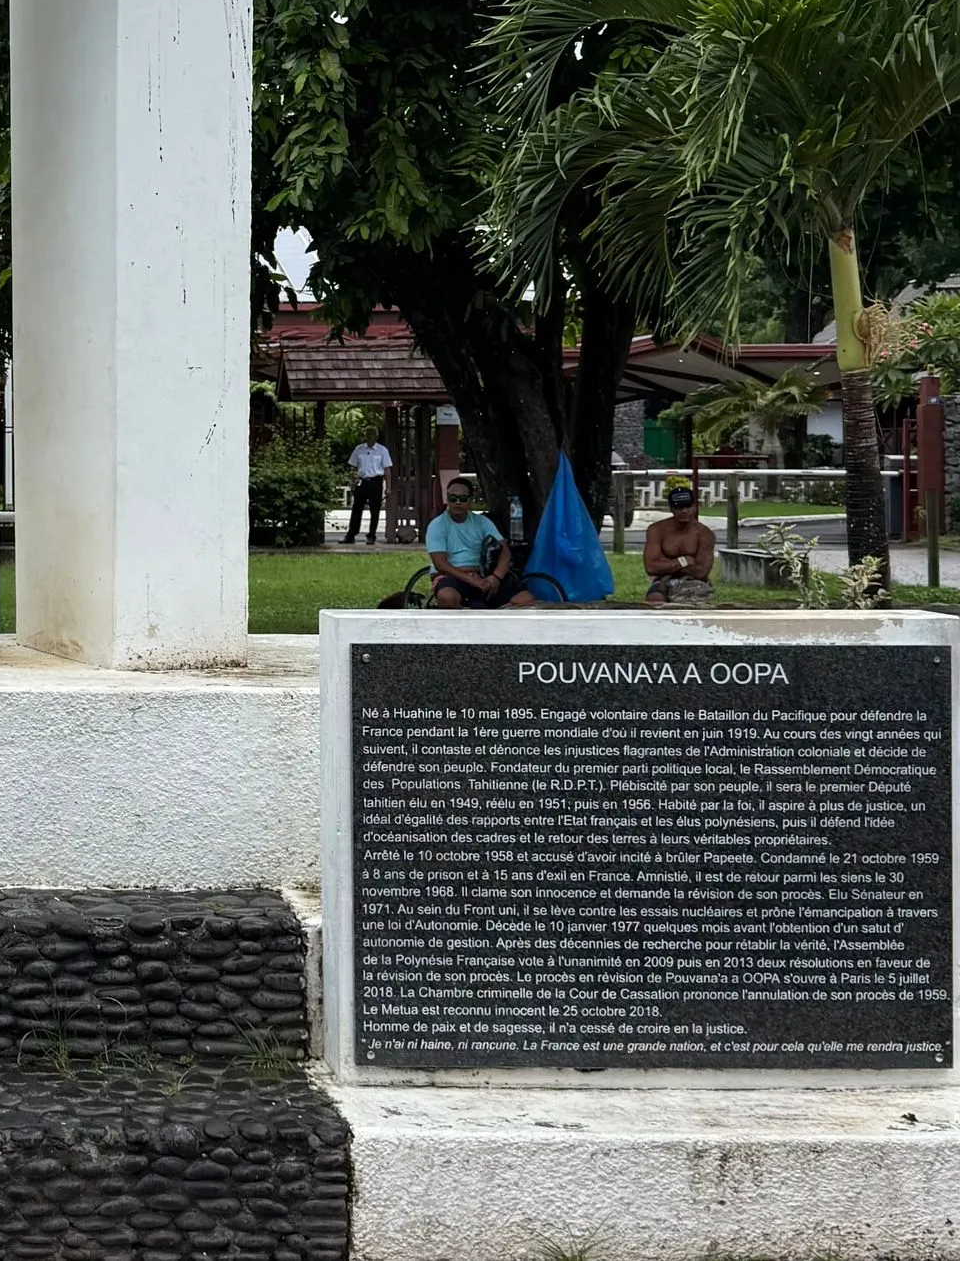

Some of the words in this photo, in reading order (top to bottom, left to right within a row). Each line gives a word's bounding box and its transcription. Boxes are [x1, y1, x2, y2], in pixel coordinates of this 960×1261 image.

[518, 662, 677, 684] POUVANA'A
[682, 662, 702, 684] A
[710, 663, 790, 685] OOPA
[361, 707, 379, 719] Né
[382, 707, 390, 719] à
[392, 707, 442, 720] Huahine
[445, 707, 456, 720] le
[460, 707, 475, 720] 10
[478, 707, 500, 720] mai
[504, 707, 537, 720] 1895.
[539, 707, 586, 723] Engagé
[589, 707, 648, 720] volontaire
[650, 707, 680, 721] dans
[683, 708, 695, 721] le
[697, 708, 750, 721] Bataillon
[752, 708, 768, 721] du
[770, 708, 826, 723] Pacifique
[829, 711, 857, 723] pour
[859, 708, 913, 721] défendre
[915, 708, 927, 721] la
[361, 724, 403, 737] France
[406, 724, 454, 740] pendant
[457, 724, 468, 737] la
[473, 725, 499, 737] 1ère
[501, 728, 540, 740] guerre
[543, 725, 598, 738] mondiale
[629, 725, 637, 738] il
[639, 725, 680, 738] revient
[683, 729, 699, 739] en
[701, 726, 723, 741] juin
[728, 726, 761, 739] 1919.
[762, 726, 780, 739] Au
[782, 729, 816, 739] cours
[818, 726, 841, 739] des
[844, 726, 873, 742] vingt
[876, 727, 920, 739] années
[922, 727, 942, 742] qui
[450, 830, 472, 843] des
[475, 830, 516, 843] cadres
[518, 831, 531, 844] et
[533, 831, 545, 844] le
[547, 831, 583, 844] retour
[586, 831, 608, 844] des
[611, 831, 646, 844] terres
[649, 831, 657, 844] à
[660, 831, 690, 844] leurs
[692, 832, 750, 845] véritables
[753, 832, 831, 847] propriétaires.
[361, 885, 421, 898] novembre
[425, 885, 458, 898] 1968.
[460, 885, 468, 898] Il
[470, 885, 507, 898] clame
[510, 888, 532, 898] son
[534, 886, 596, 899] innocence
[599, 886, 611, 899] et
[614, 886, 670, 899] demande
[673, 886, 684, 899] la
[687, 886, 734, 899] révision
[736, 886, 752, 899] de
[755, 889, 778, 899] son
[780, 887, 825, 902] procès.
[828, 887, 848, 900] Elu
[850, 887, 905, 900] Sénateur
[908, 890, 924, 900] en
[362, 986, 397, 999] 2018.
[399, 986, 415, 999] La
[418, 986, 473, 999] Chambre
[476, 986, 533, 999] criminelle
[535, 987, 552, 1000] de
[554, 987, 566, 1000] la
[568, 987, 598, 1000] Cour
[600, 987, 617, 1000] de
[619, 987, 680, 1000] Cassation
[682, 990, 739, 1002] prononce
[811, 987, 827, 1001] de
[830, 991, 852, 1001] son
[854, 988, 896, 1003] procès
[898, 988, 914, 1001] de
[918, 988, 952, 1001] 1959.
[362, 1003, 378, 1016] Le
[380, 1003, 418, 1016] Metua
[420, 1003, 440, 1016] est
[442, 1006, 491, 1016] reconnu
[494, 1003, 546, 1017] innocent
[548, 1004, 560, 1017] le
[562, 1004, 578, 1017] 25
[580, 1004, 626, 1017] octobre
[628, 1004, 663, 1017] 2018.
